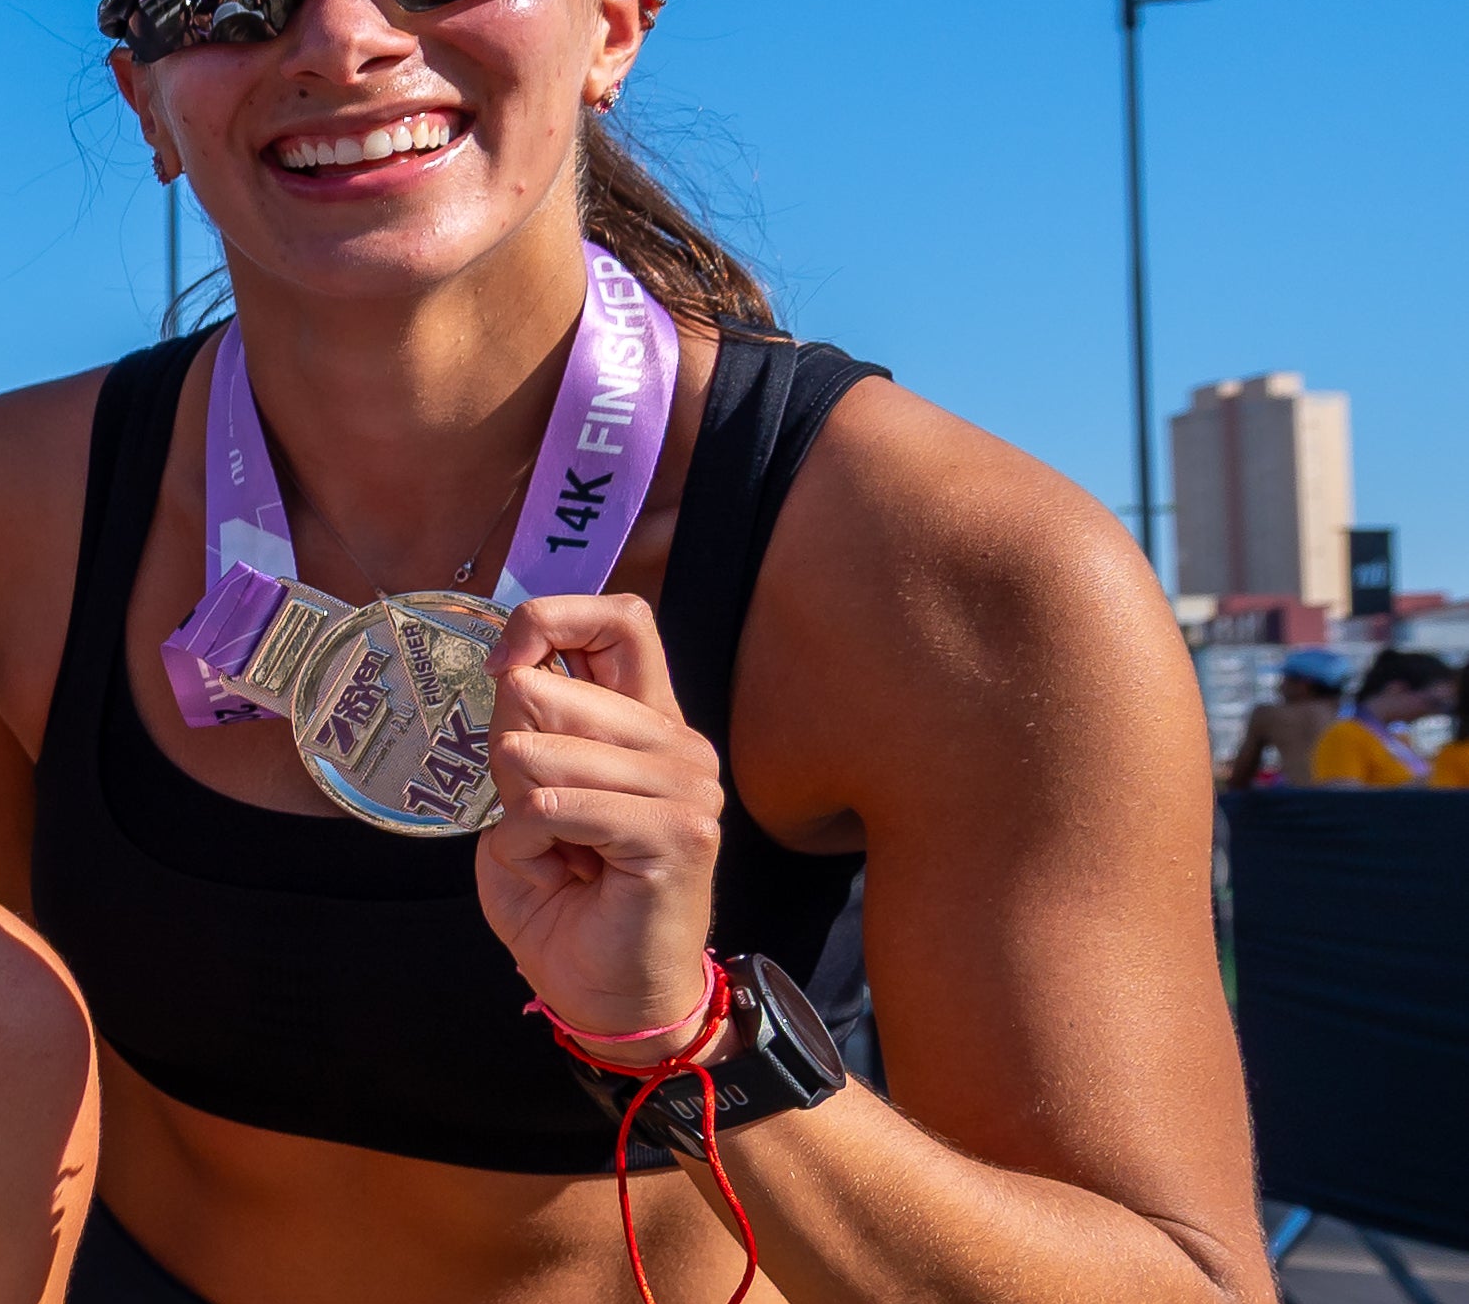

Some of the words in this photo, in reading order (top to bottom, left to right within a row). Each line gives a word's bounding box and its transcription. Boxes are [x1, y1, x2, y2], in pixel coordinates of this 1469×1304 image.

[545, 466, 614, 554] 14K
[402, 621, 443, 708] FINISHER
[404, 708, 490, 816] 14K
